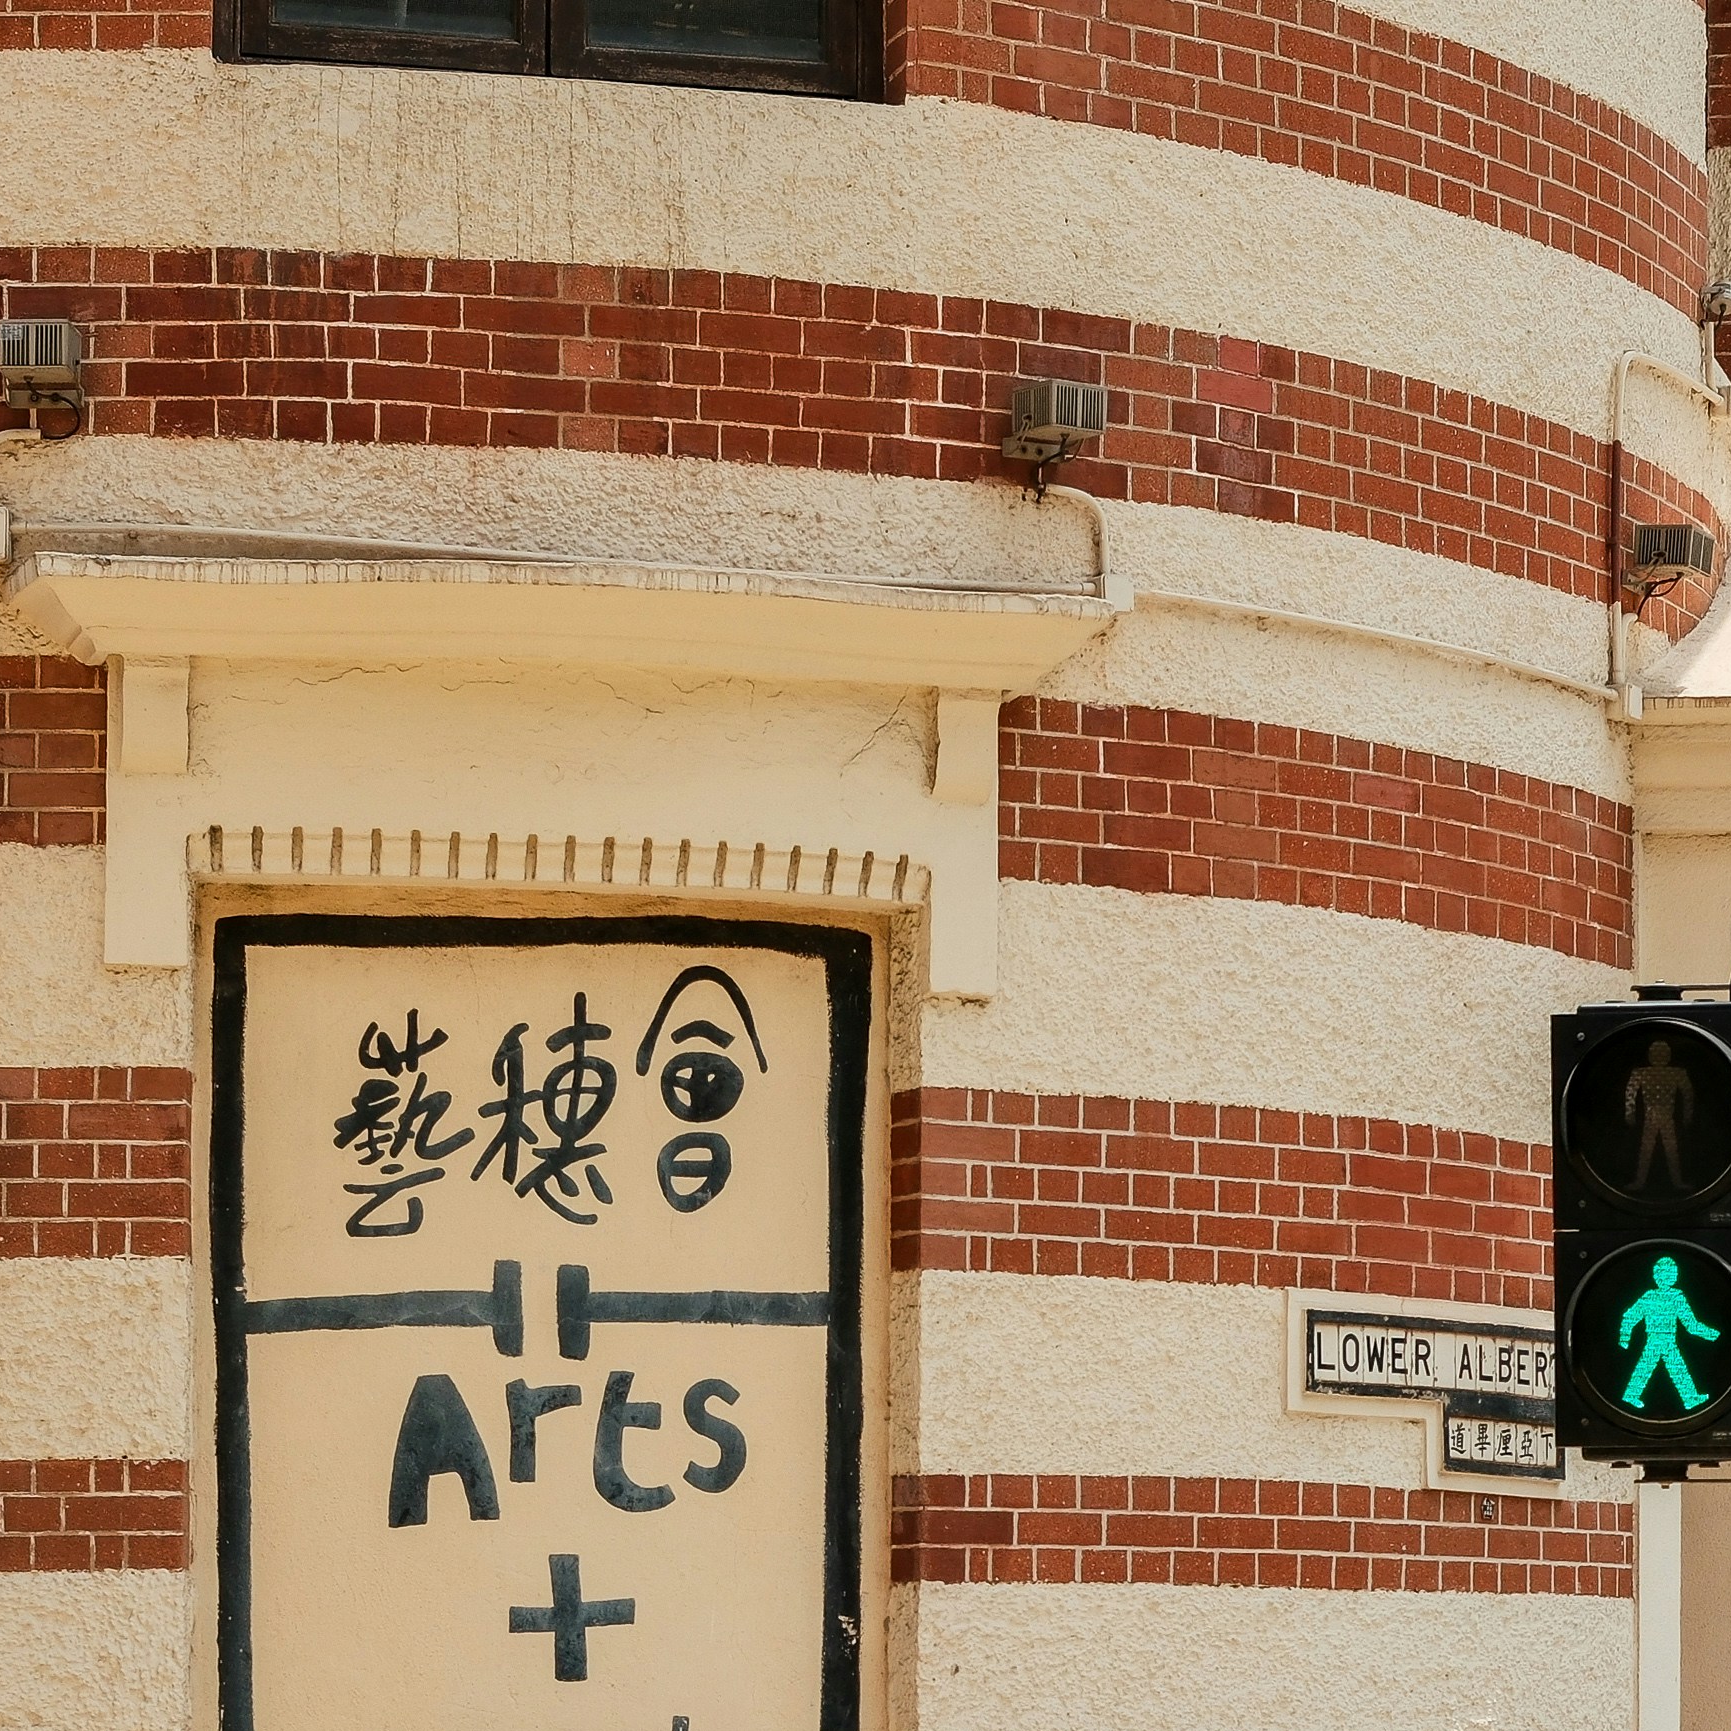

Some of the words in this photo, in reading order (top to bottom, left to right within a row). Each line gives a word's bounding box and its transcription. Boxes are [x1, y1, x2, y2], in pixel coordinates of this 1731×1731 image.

[1315, 1330, 1432, 1377] LOWER
[1458, 1343, 1555, 1389] ALBER
[387, 1370, 748, 1529] Arts
